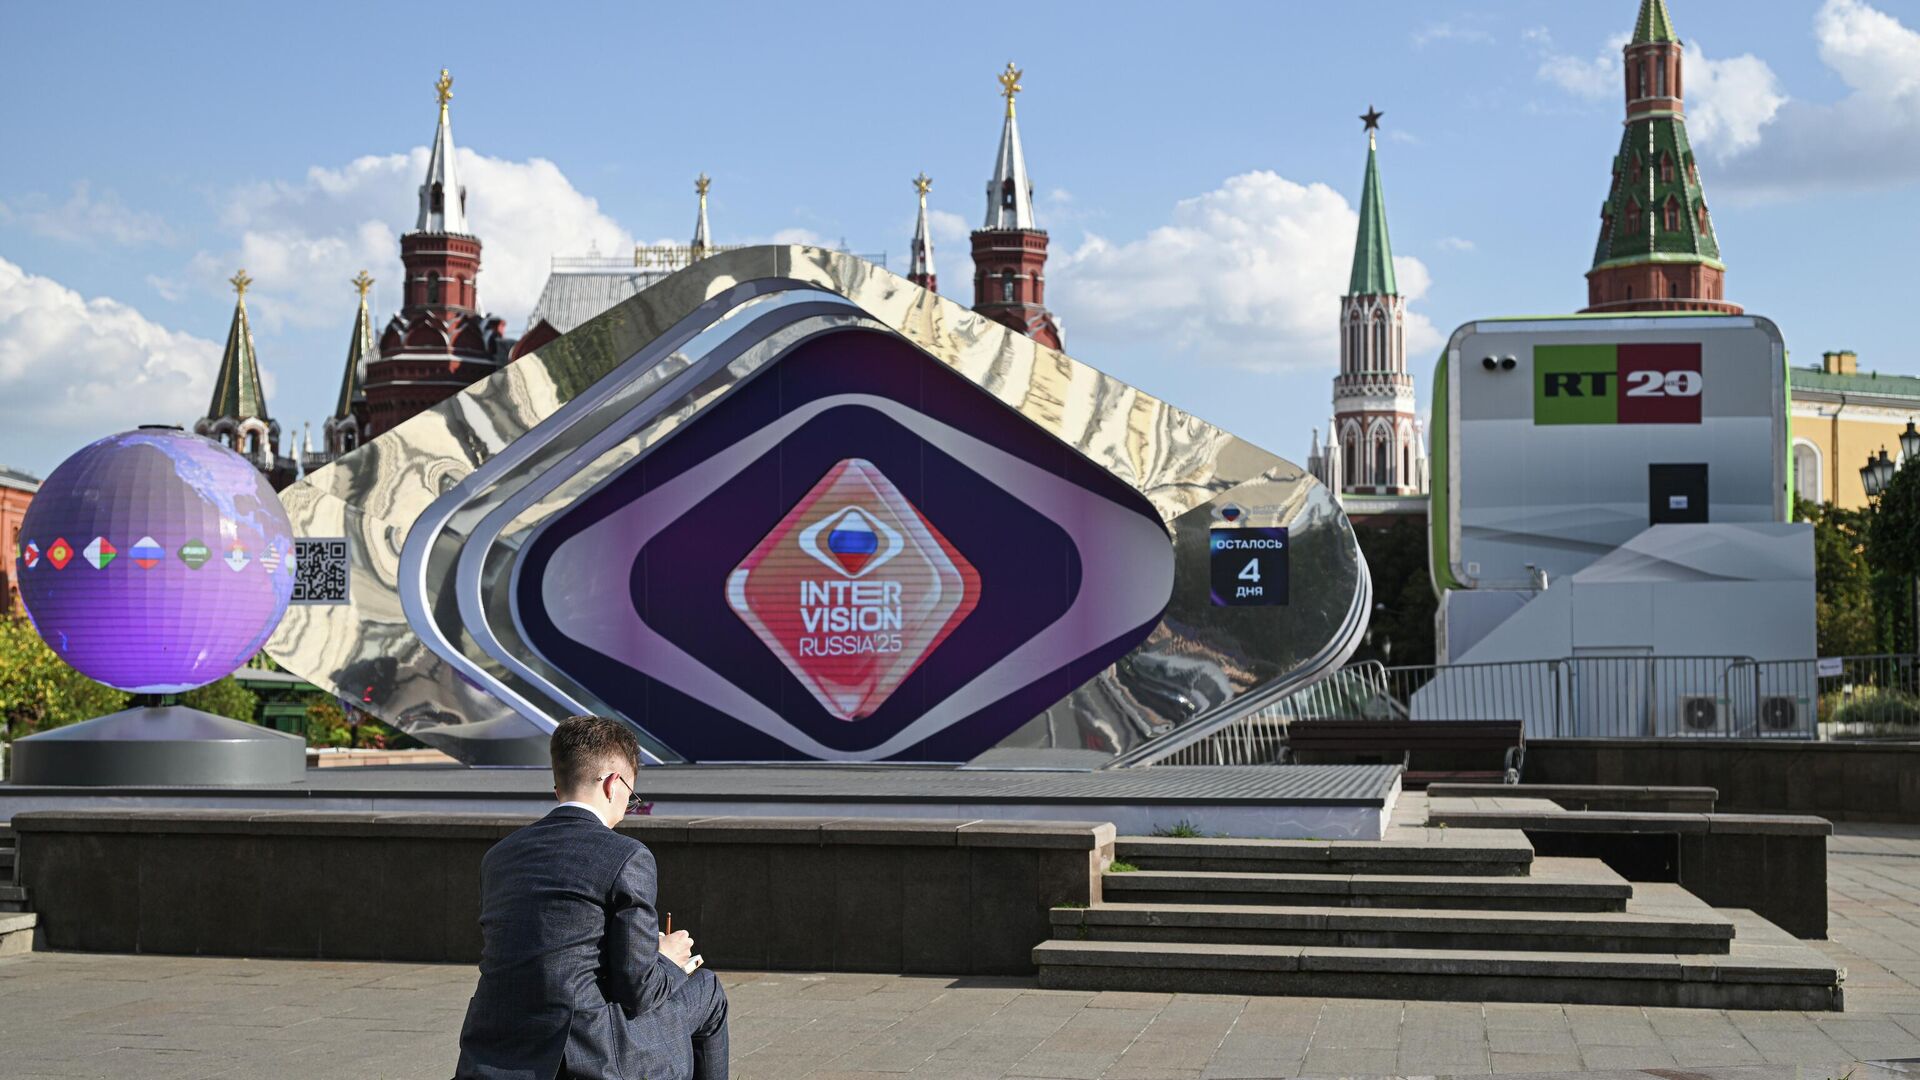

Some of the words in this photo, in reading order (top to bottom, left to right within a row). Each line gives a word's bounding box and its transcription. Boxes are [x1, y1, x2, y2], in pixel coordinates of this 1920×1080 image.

[1544, 371, 1617, 397] RT
[1216, 539, 1283, 549] ОСТАЛОСЬ
[1238, 558, 1261, 582] 4
[800, 580, 903, 605] INTER
[1236, 586, 1263, 598] ДНЯ
[800, 606, 903, 633] VISION
